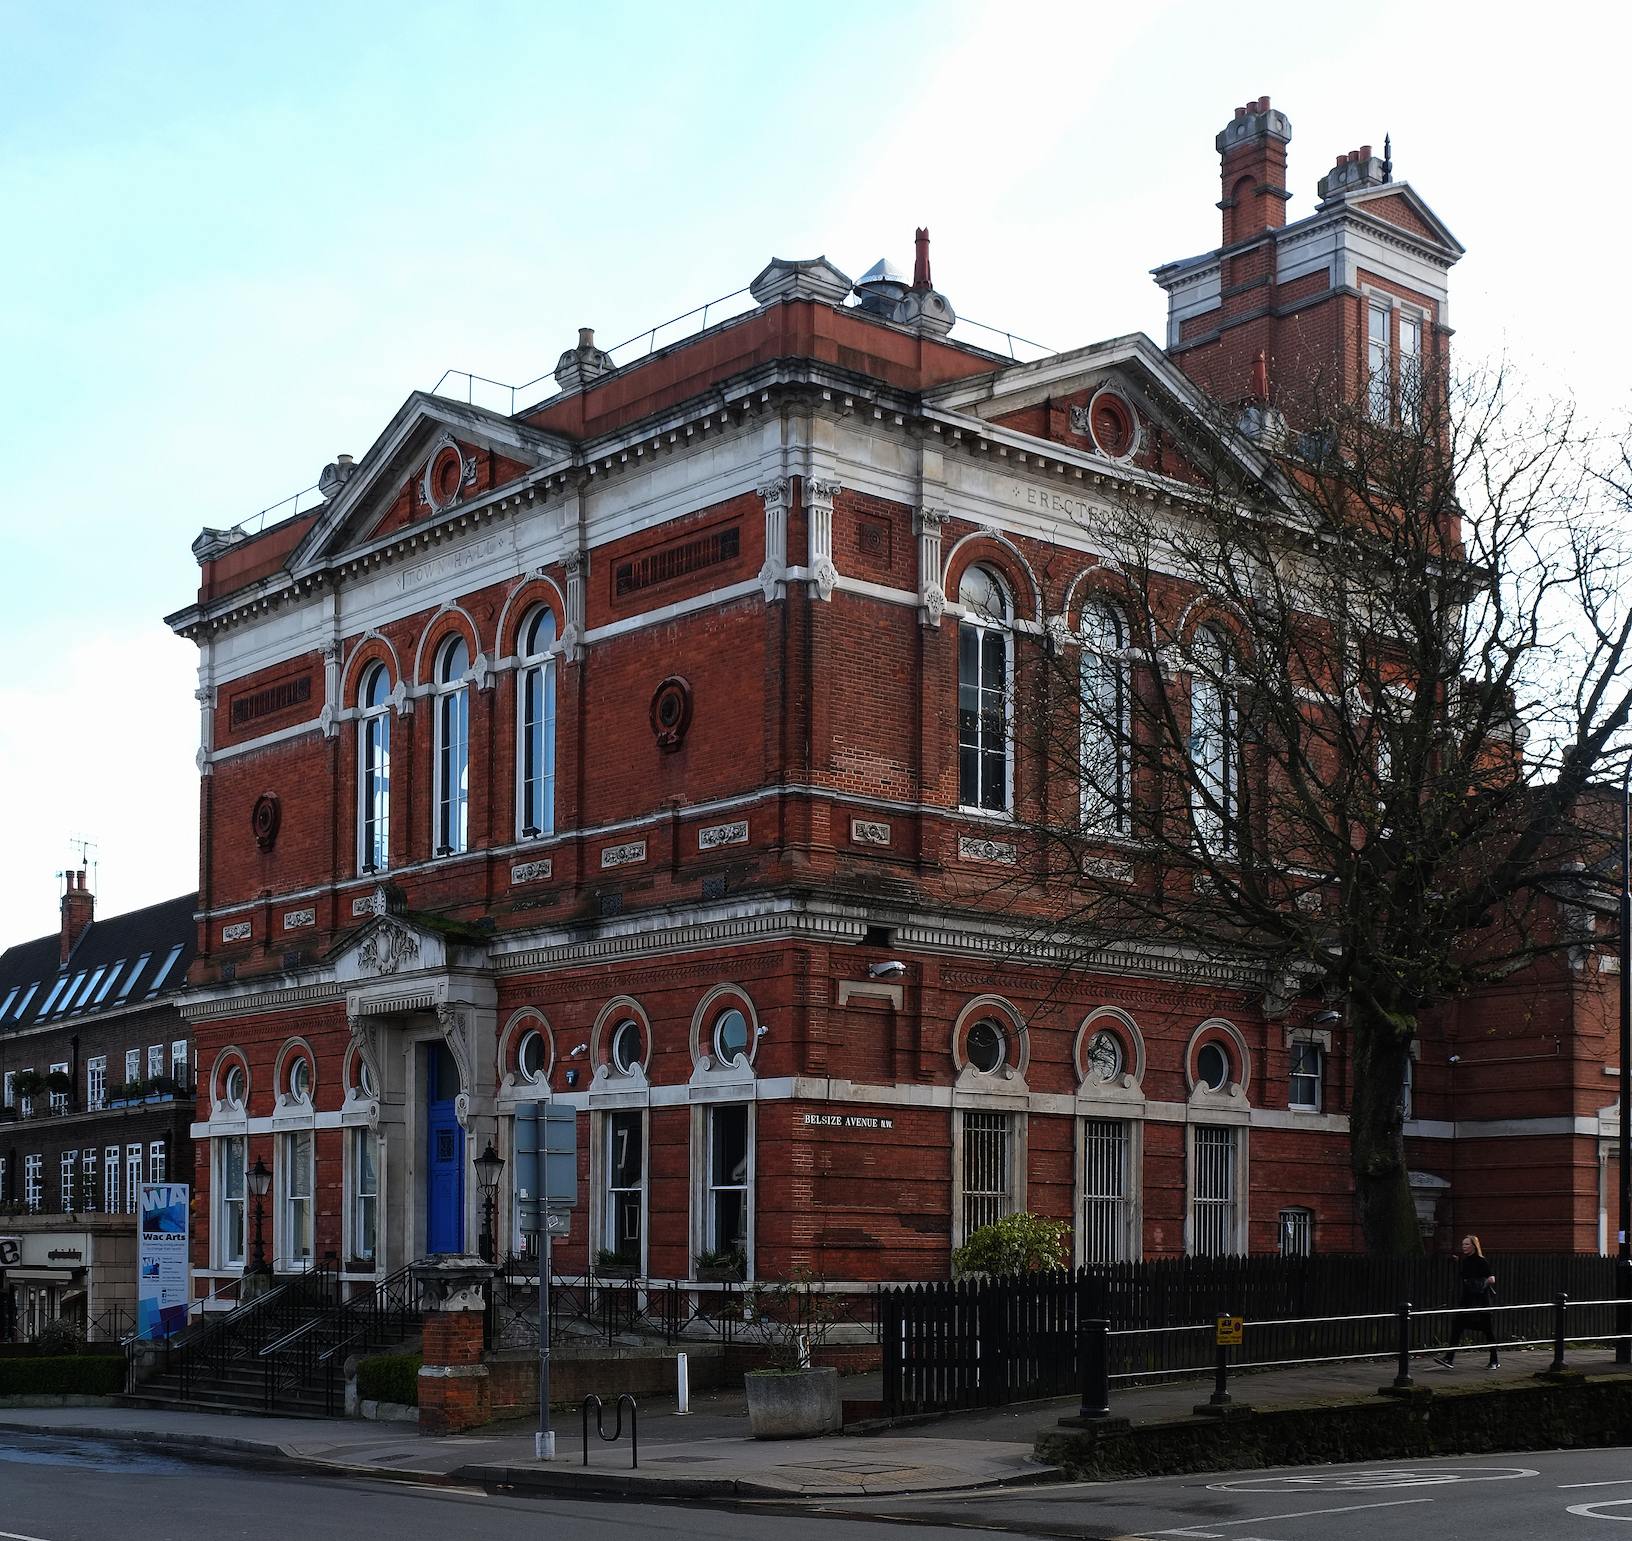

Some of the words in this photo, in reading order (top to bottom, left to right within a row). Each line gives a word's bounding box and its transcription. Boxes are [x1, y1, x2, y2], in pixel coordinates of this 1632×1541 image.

[407, 559, 447, 586] TOWN
[454, 542, 495, 568] HALL
[804, 1114, 842, 1126] BELSIZE
[845, 1116, 878, 1128] AVENUE
[143, 1233, 164, 1241] Wac
[165, 1233, 186, 1241] Arts
